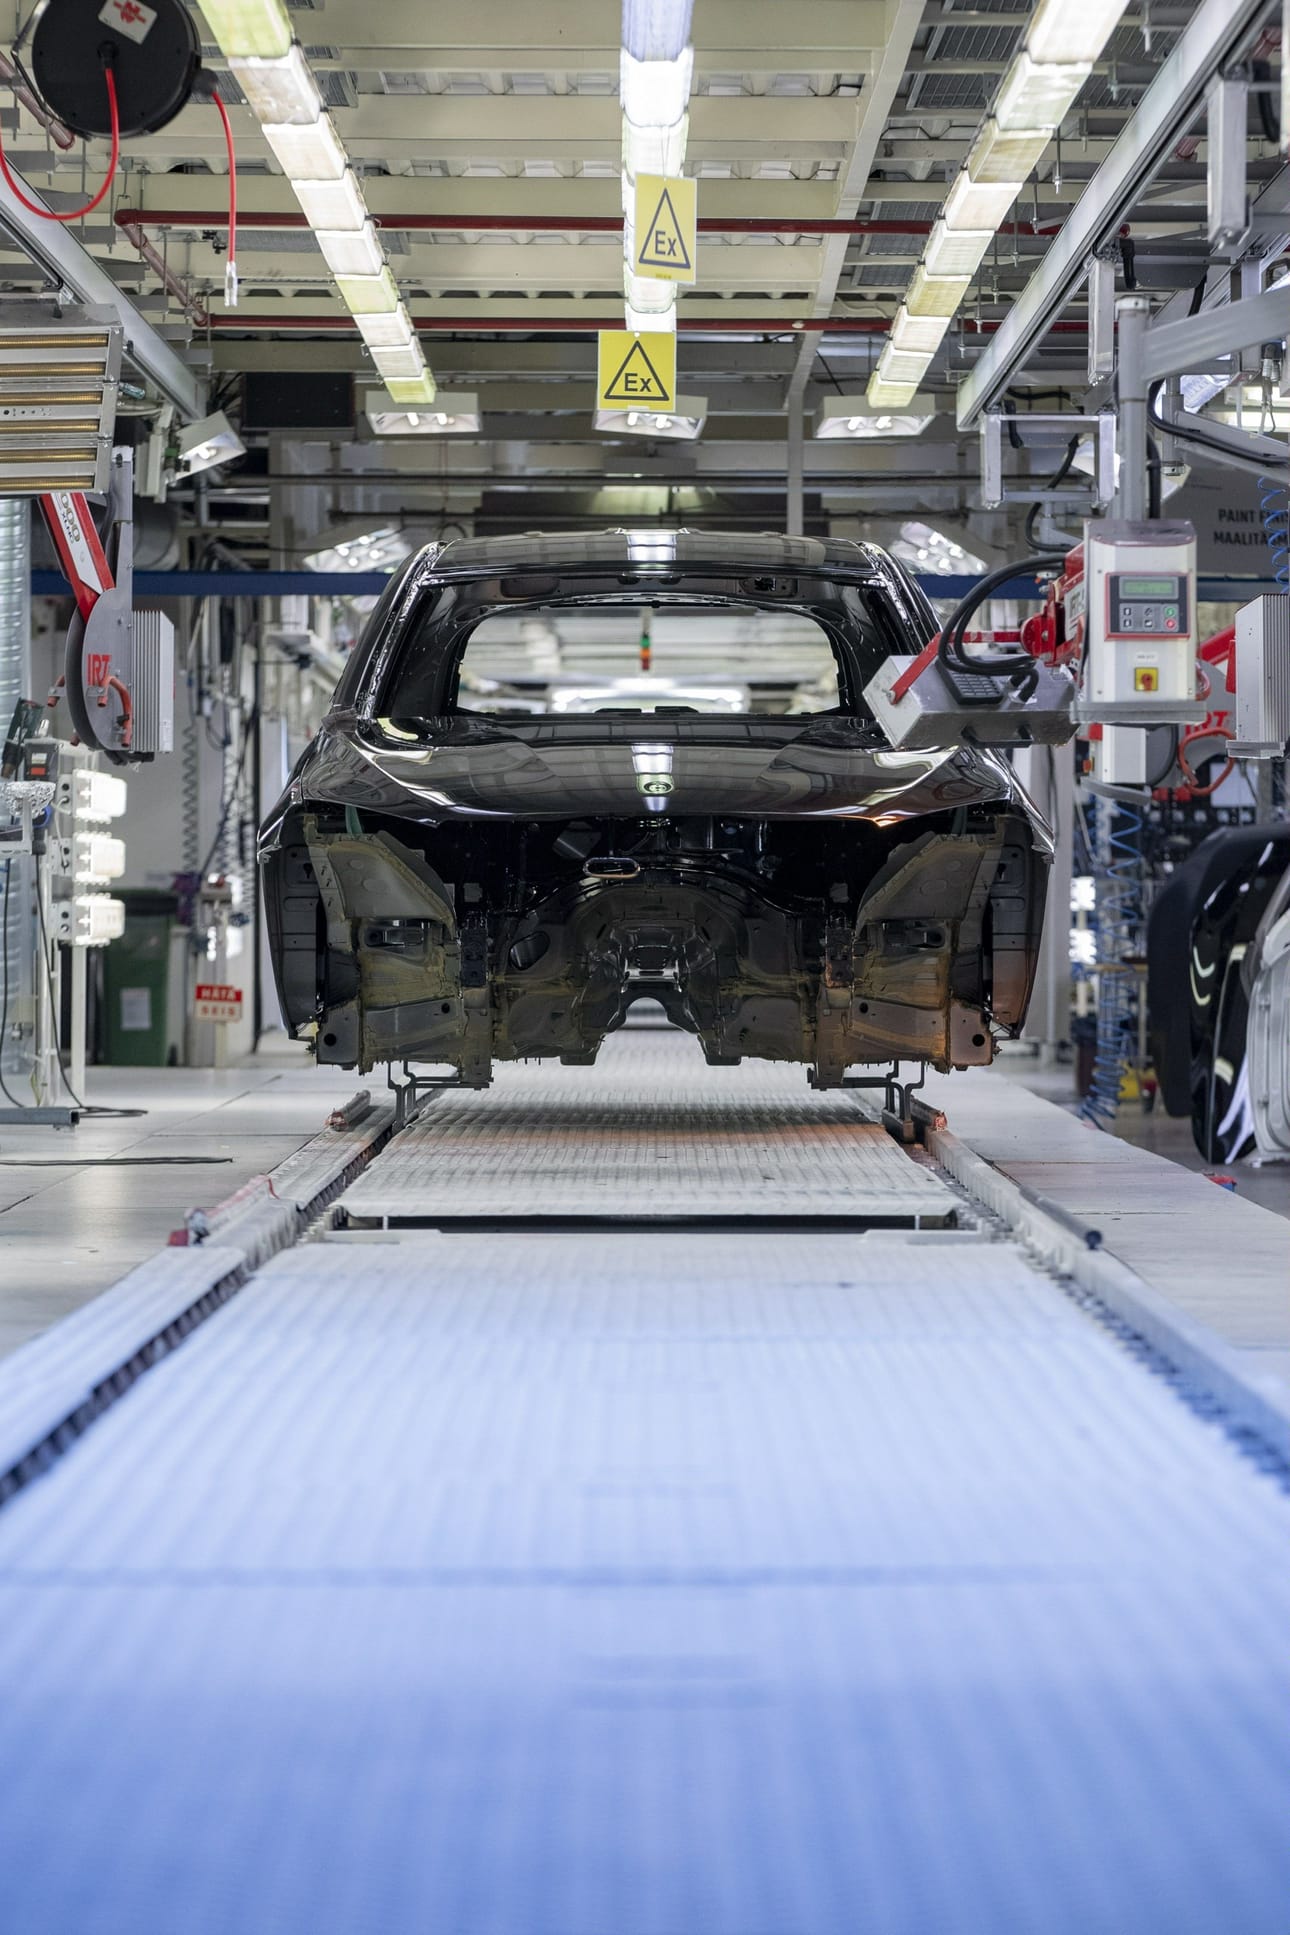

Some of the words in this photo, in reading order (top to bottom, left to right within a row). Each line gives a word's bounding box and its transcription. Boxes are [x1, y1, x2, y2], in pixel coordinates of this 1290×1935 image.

[654, 230, 677, 257] Ex
[624, 373, 652, 393] Ex
[1218, 508, 1255, 522] PAINT
[87, 653, 112, 687] IRT
